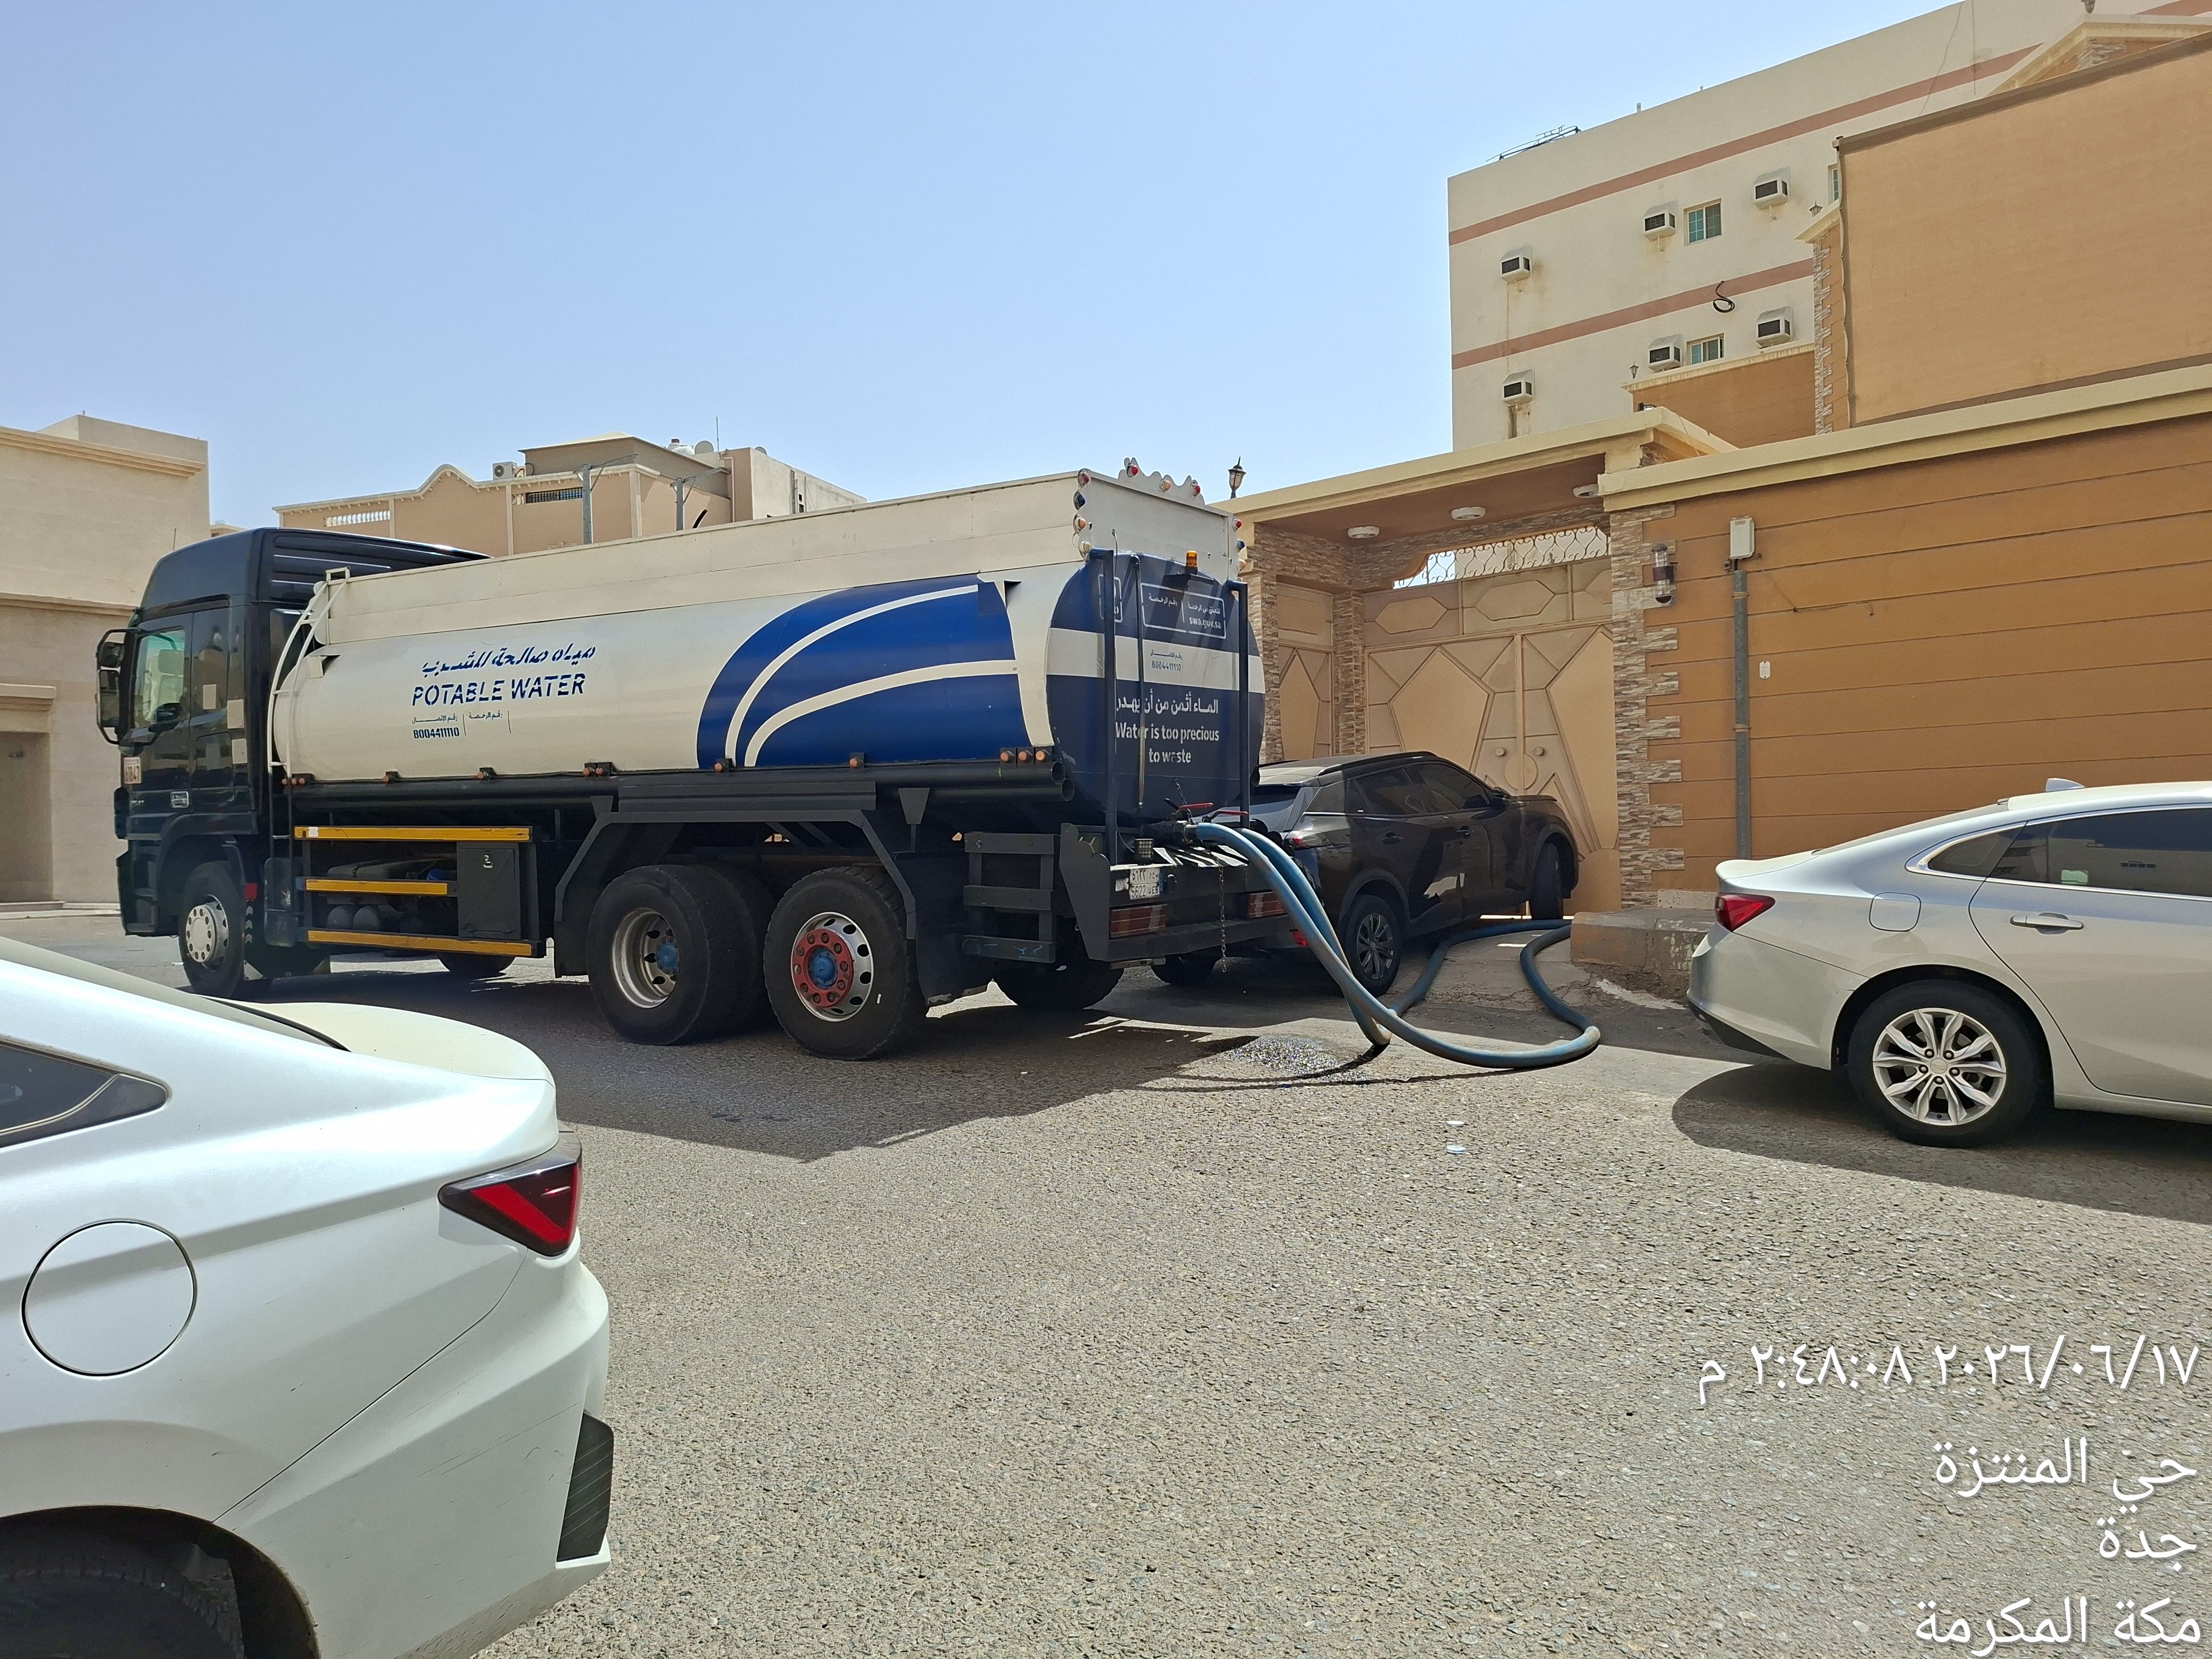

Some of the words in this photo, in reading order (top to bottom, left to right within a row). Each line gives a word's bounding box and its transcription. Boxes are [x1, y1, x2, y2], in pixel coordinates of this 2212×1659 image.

[1148, 593, 1168, 605] الرخصة
[1169, 597, 1178, 608] رقم
[1189, 617, 1221, 629] swa.gov.sa
[492, 646, 549, 667] صالحة
[551, 642, 596, 666] مياه
[1152, 660, 1182, 672] 8004411110
[412, 679, 505, 706] POTABLE
[511, 673, 586, 699] WATER
[1144, 689, 1154, 713] أن
[1155, 698, 1169, 715] من
[1171, 691, 1192, 715] أثمن
[1194, 697, 1219, 714] الماء
[448, 713, 458, 724] رقم
[468, 711, 491, 720] الرخصة
[492, 710, 503, 721] رقم
[413, 727, 460, 739] 8004411110
[1115, 722, 1149, 739] Watr
[1151, 723, 1160, 739] is
[1161, 725, 1179, 740] too
[1180, 725, 1220, 744] precious
[1149, 748, 1160, 763] to
[1162, 749, 1192, 763] waste
[1131, 885, 1146, 898] 5622
[1148, 885, 1159, 894] UEB
